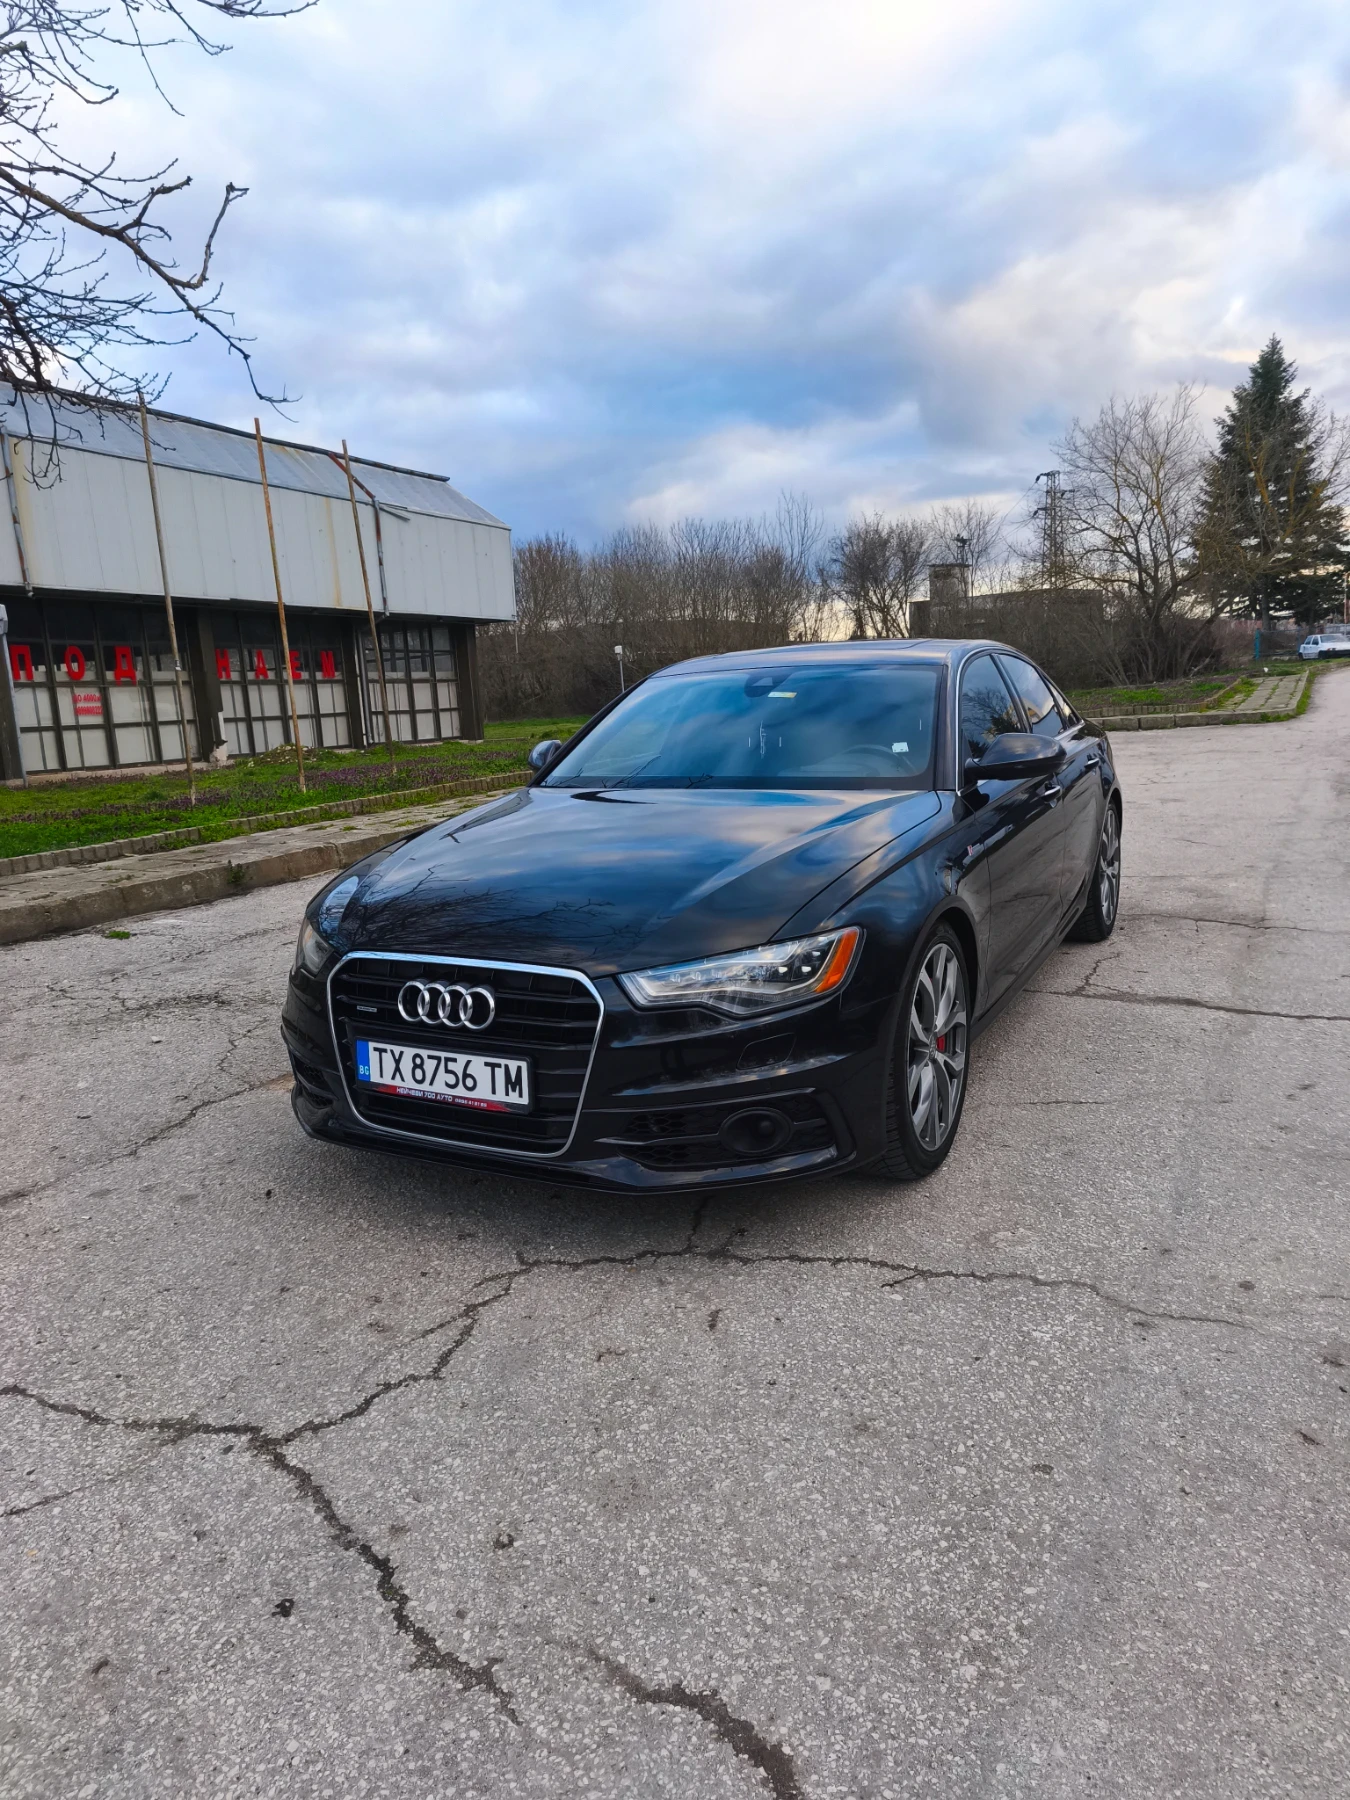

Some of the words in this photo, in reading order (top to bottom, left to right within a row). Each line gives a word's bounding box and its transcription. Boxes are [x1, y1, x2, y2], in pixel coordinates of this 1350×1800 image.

[9, 644, 137, 686] ПОД
[215, 648, 336, 680] НАЕМ
[359, 1065, 370, 1076] BG
[411, 1053, 478, 1092] 8756
[484, 1061, 524, 1099] TM
[437, 1093, 453, 1102] АУТО
